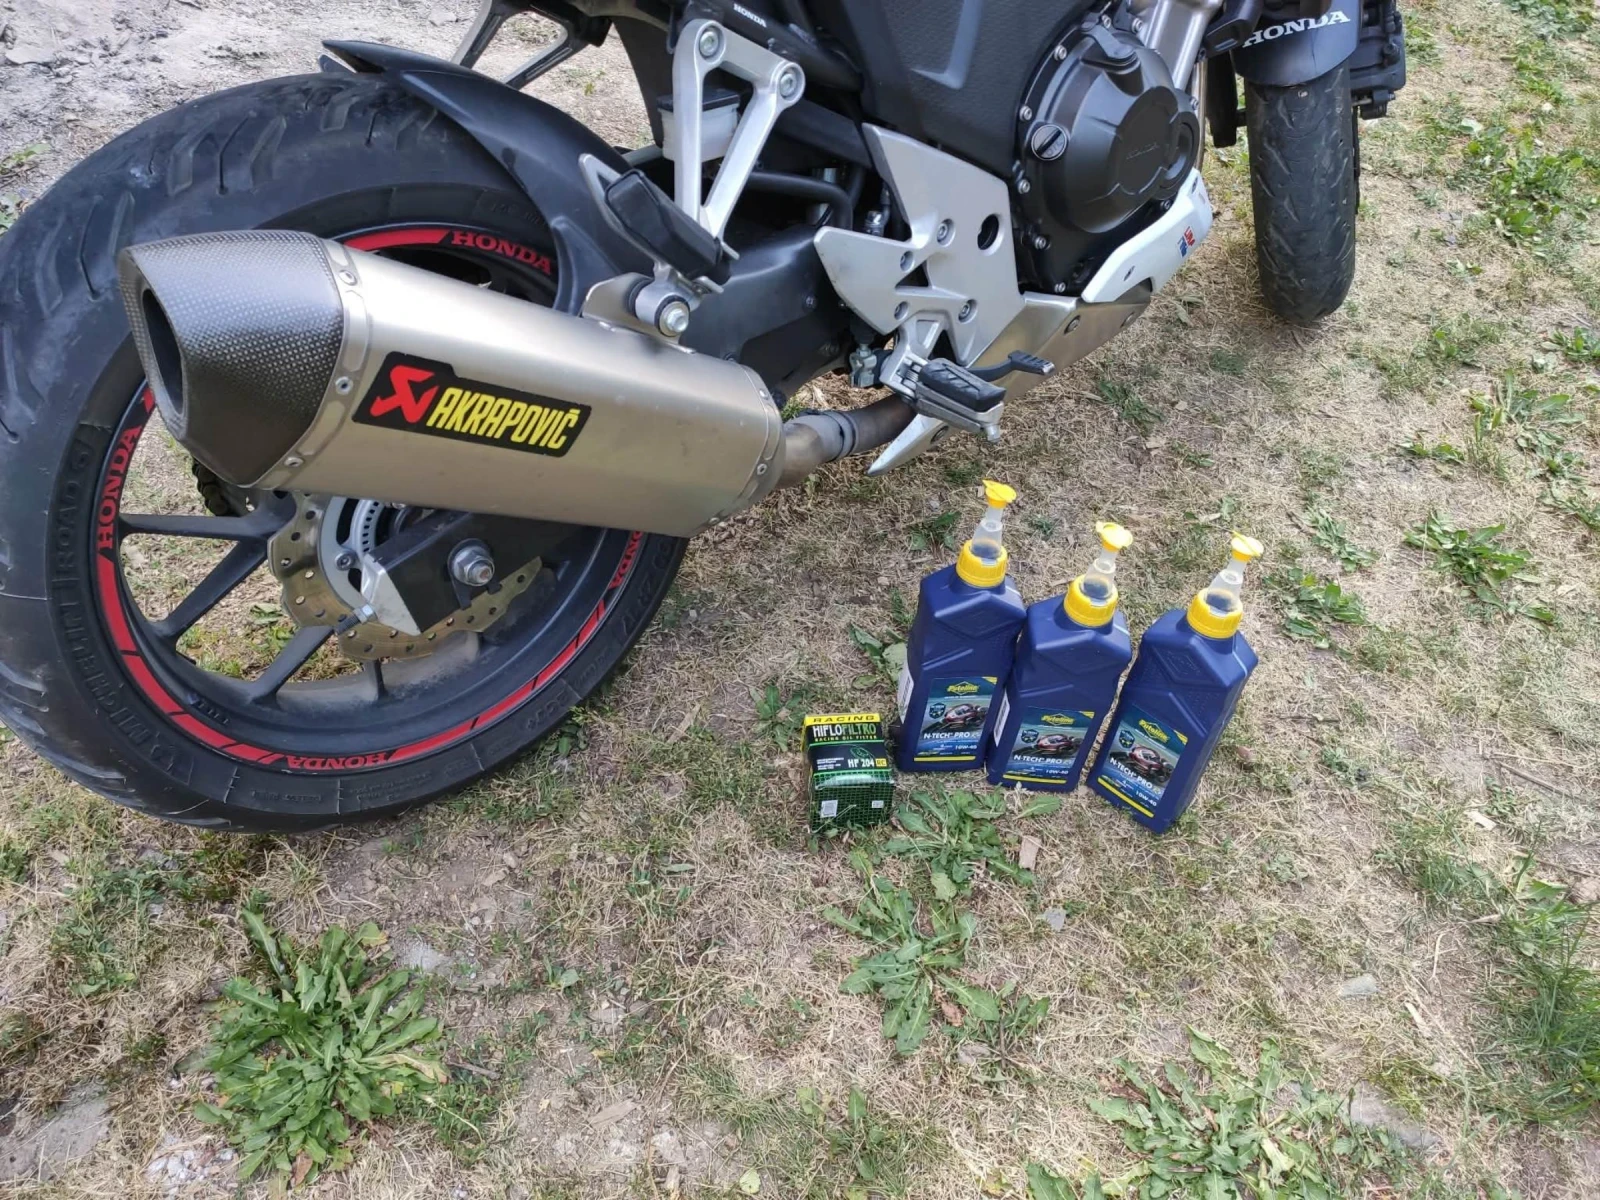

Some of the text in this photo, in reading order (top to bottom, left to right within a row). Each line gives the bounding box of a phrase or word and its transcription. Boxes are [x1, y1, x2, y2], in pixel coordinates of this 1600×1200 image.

[733, 3, 767, 28] HONDA
[1242, 10, 1351, 48] HONDA
[451, 230, 552, 275] HONDA
[96, 425, 143, 549] HONDA
[608, 530, 644, 589] ONDA
[812, 723, 877, 737] HIFLOFILTRO
[286, 752, 389, 771] HONDA
[861, 758, 875, 768] 204
[1137, 775, 1153, 789] PRO
